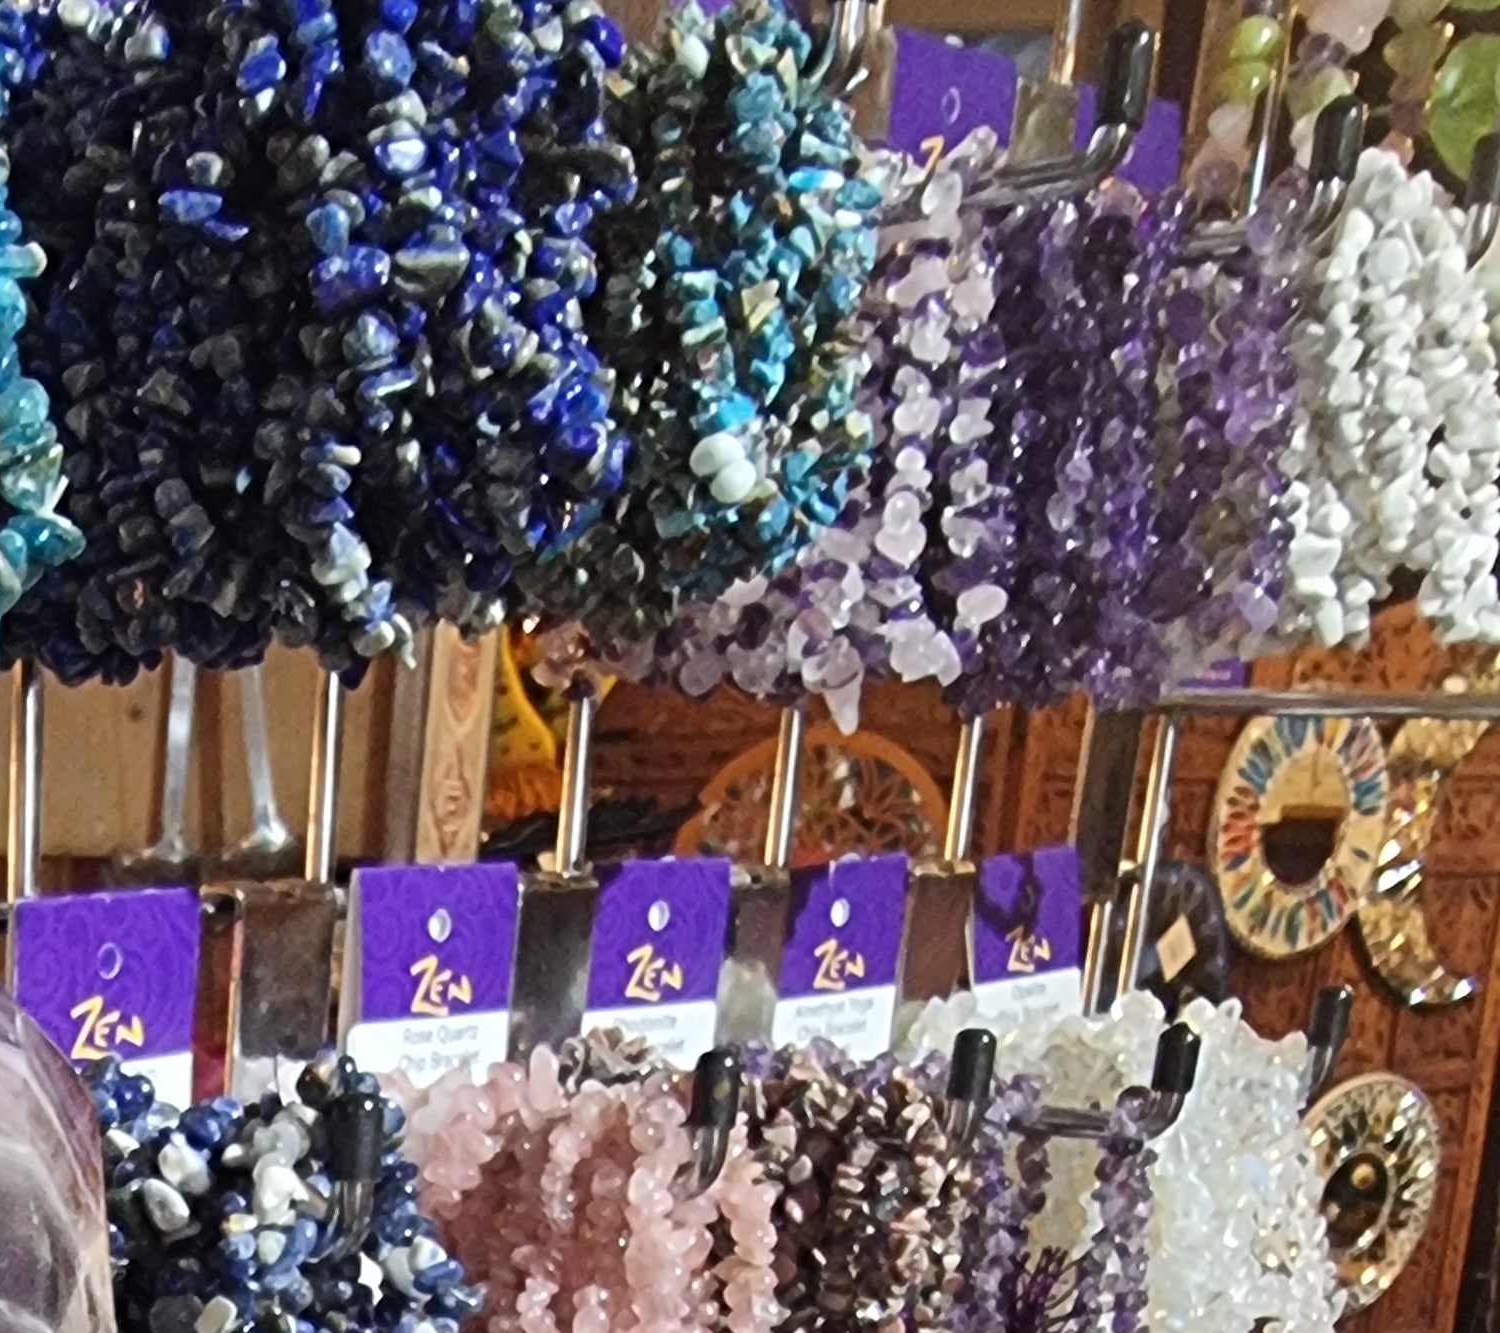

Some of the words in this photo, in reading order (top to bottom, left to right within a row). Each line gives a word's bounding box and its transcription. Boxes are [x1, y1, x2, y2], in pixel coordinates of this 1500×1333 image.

[626, 943, 683, 1003] ZEN
[813, 938, 865, 990] ZEN
[1004, 926, 1051, 973] ZEN
[409, 954, 473, 1018] ZEN
[70, 995, 144, 1060] ZEN
